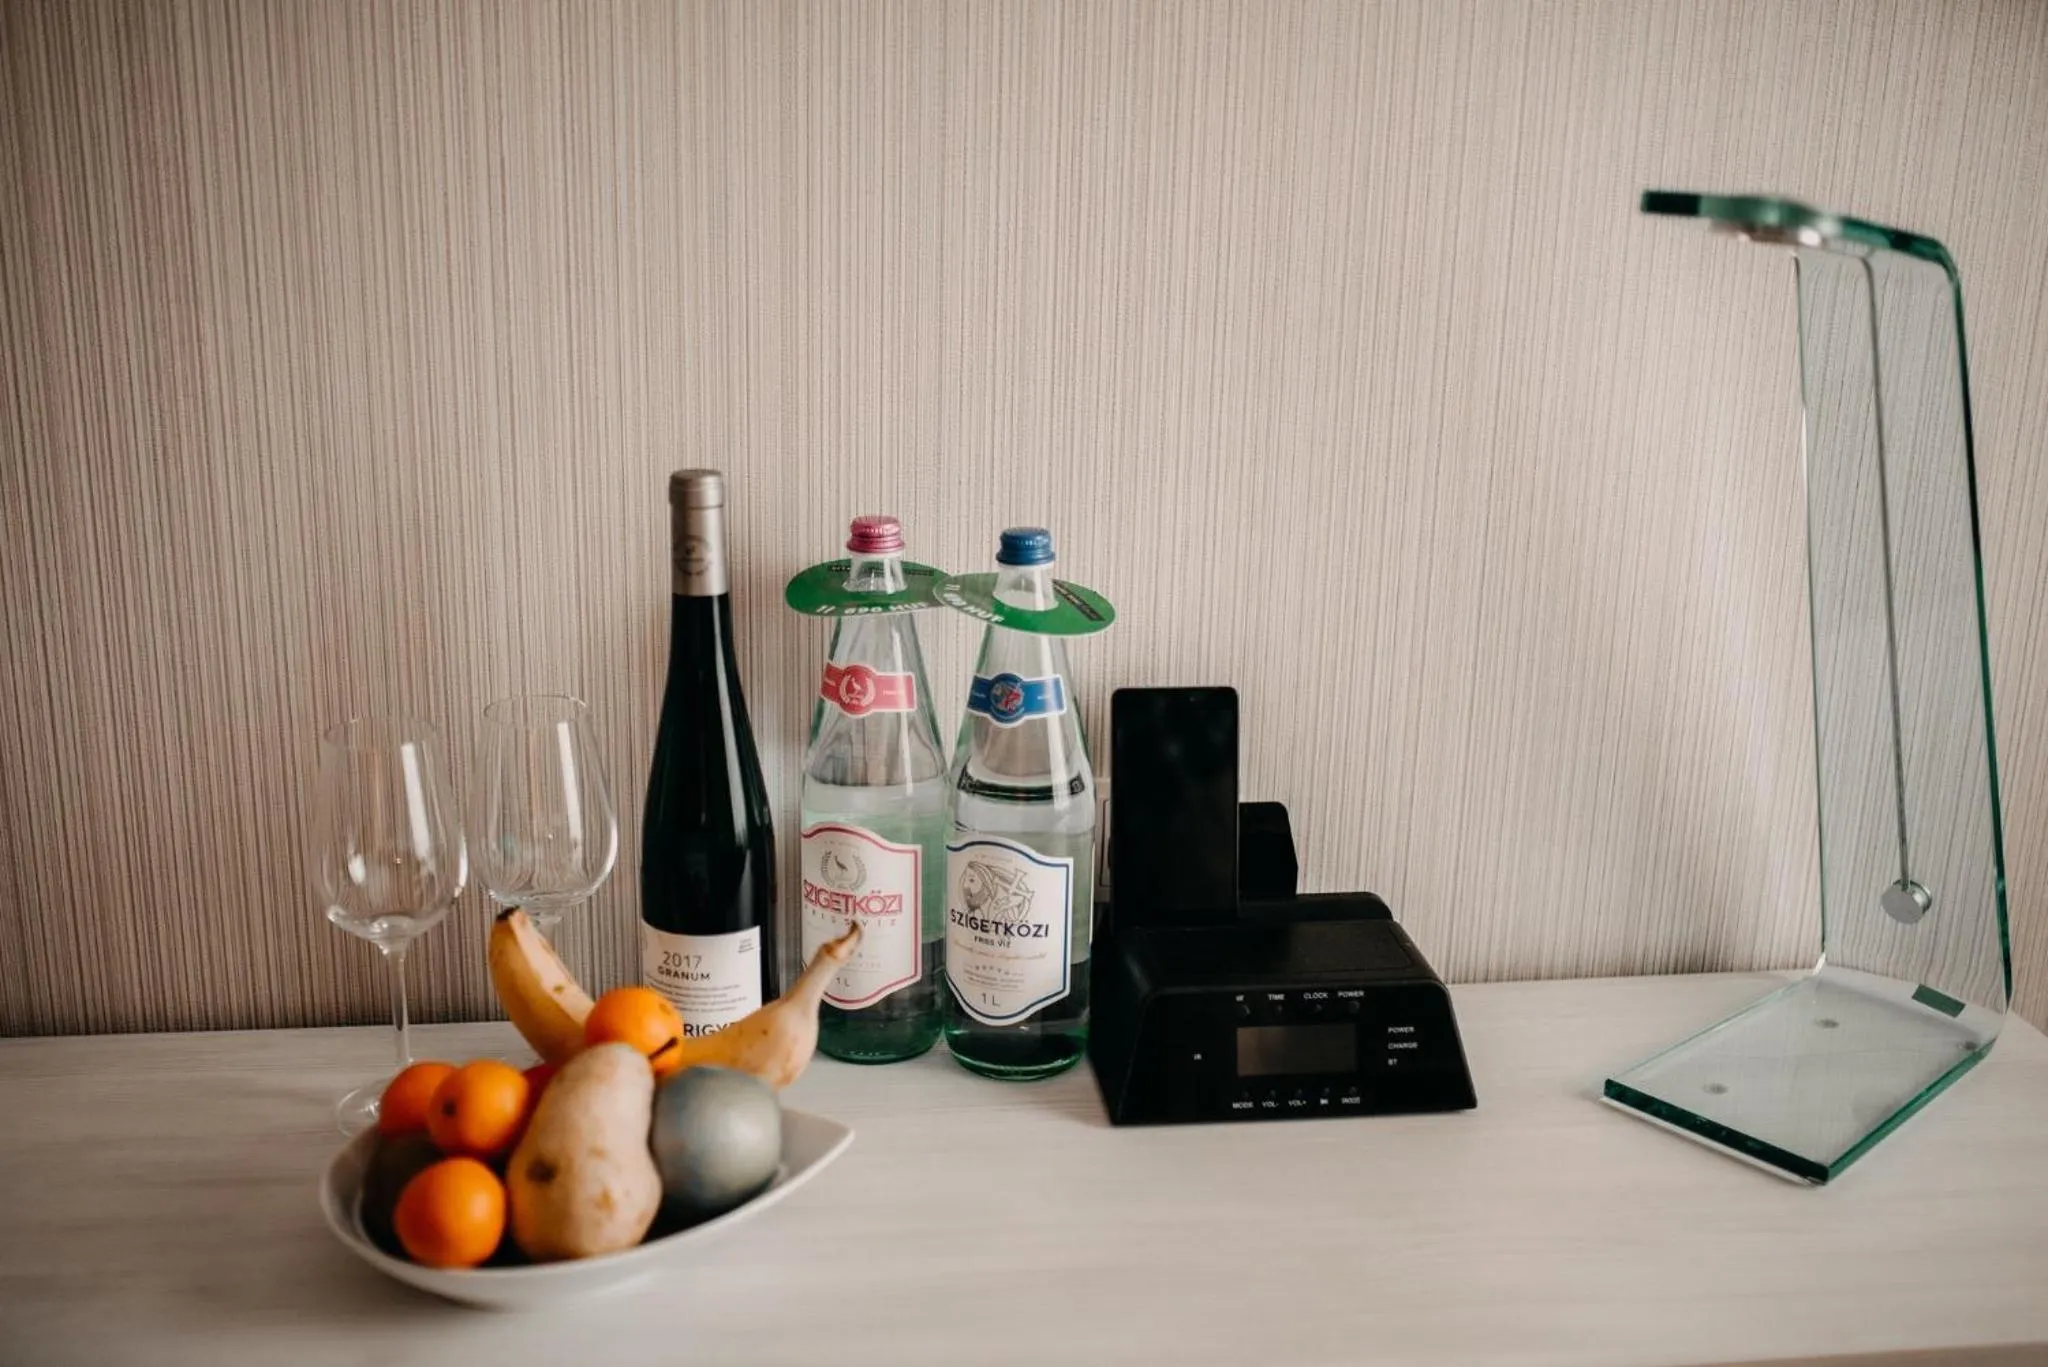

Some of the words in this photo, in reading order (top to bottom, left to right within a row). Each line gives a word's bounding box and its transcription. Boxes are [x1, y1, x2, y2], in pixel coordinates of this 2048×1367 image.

[803, 879, 903, 915] SZIGETKÖZI
[950, 908, 1050, 938] SZIGETKÖZI
[663, 951, 702, 970] 2017
[657, 965, 711, 982] GRANUM
[1267, 993, 1285, 1001] TIME
[1303, 992, 1329, 1001] CLOCK
[1337, 990, 1365, 998] POWER
[683, 1022, 736, 1037] RIGY
[1387, 1026, 1415, 1034] POWER
[1387, 1041, 1419, 1050] CHARGE
[1232, 1101, 1254, 1109] MODE
